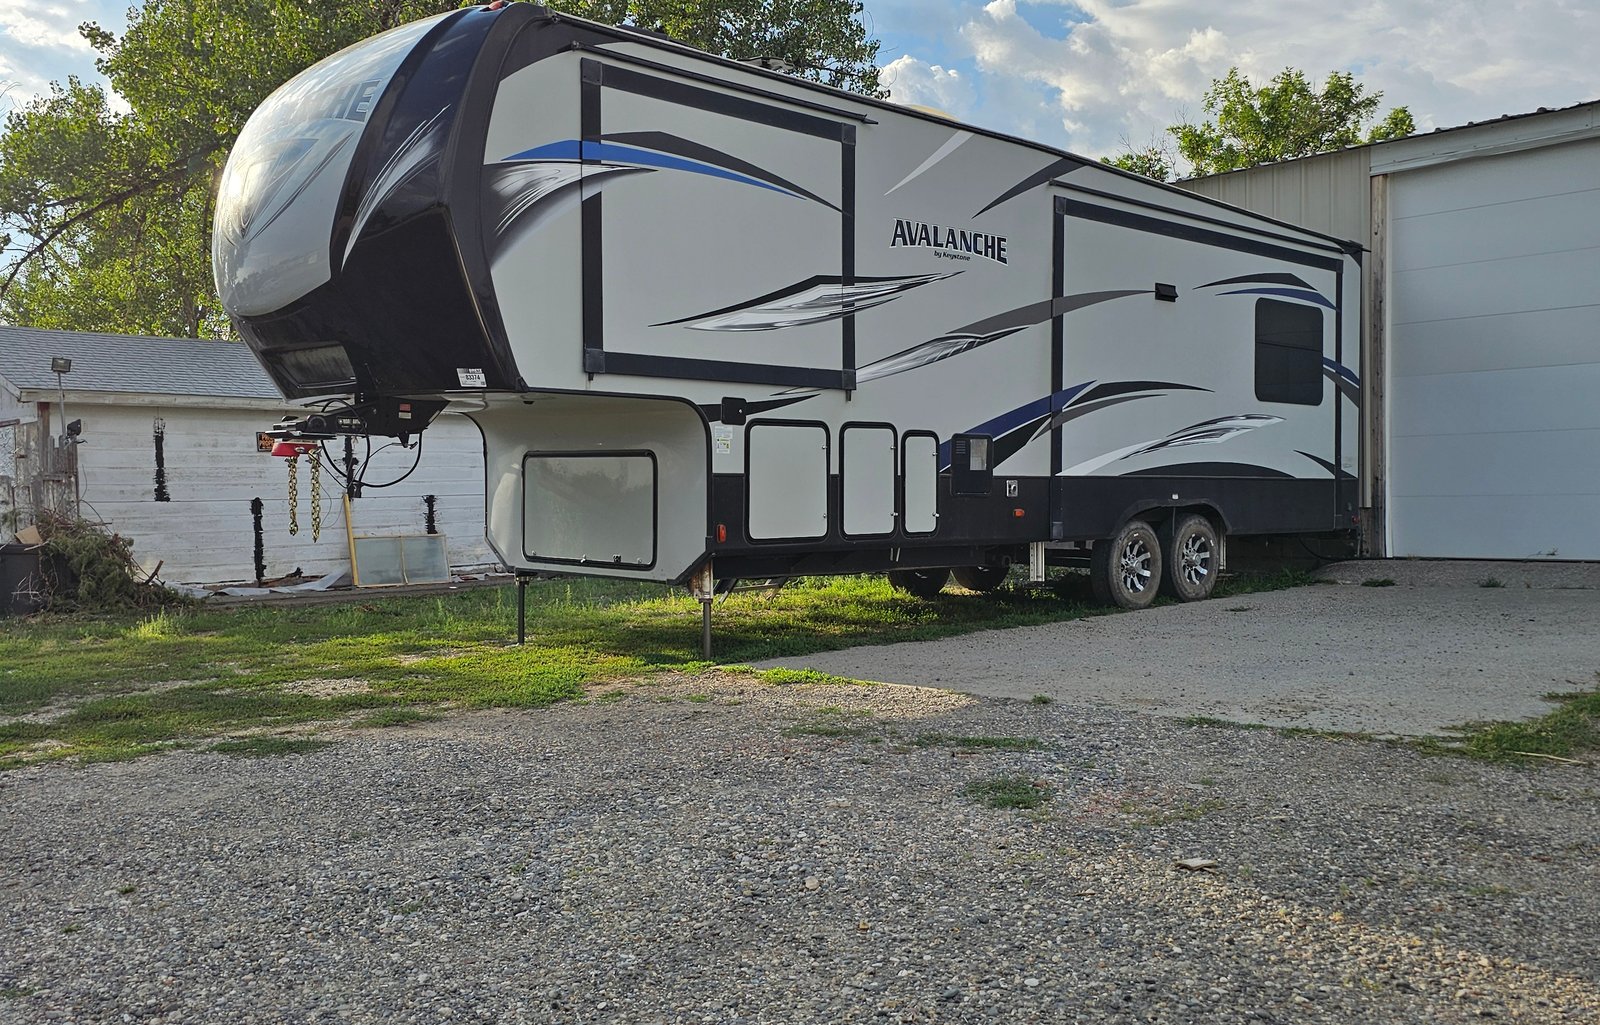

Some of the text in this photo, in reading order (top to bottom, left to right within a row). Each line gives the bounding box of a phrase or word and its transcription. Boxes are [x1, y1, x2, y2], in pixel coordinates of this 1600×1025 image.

[890, 218, 1008, 265] AVALANCHE
[933, 250, 971, 261] by Keystone
